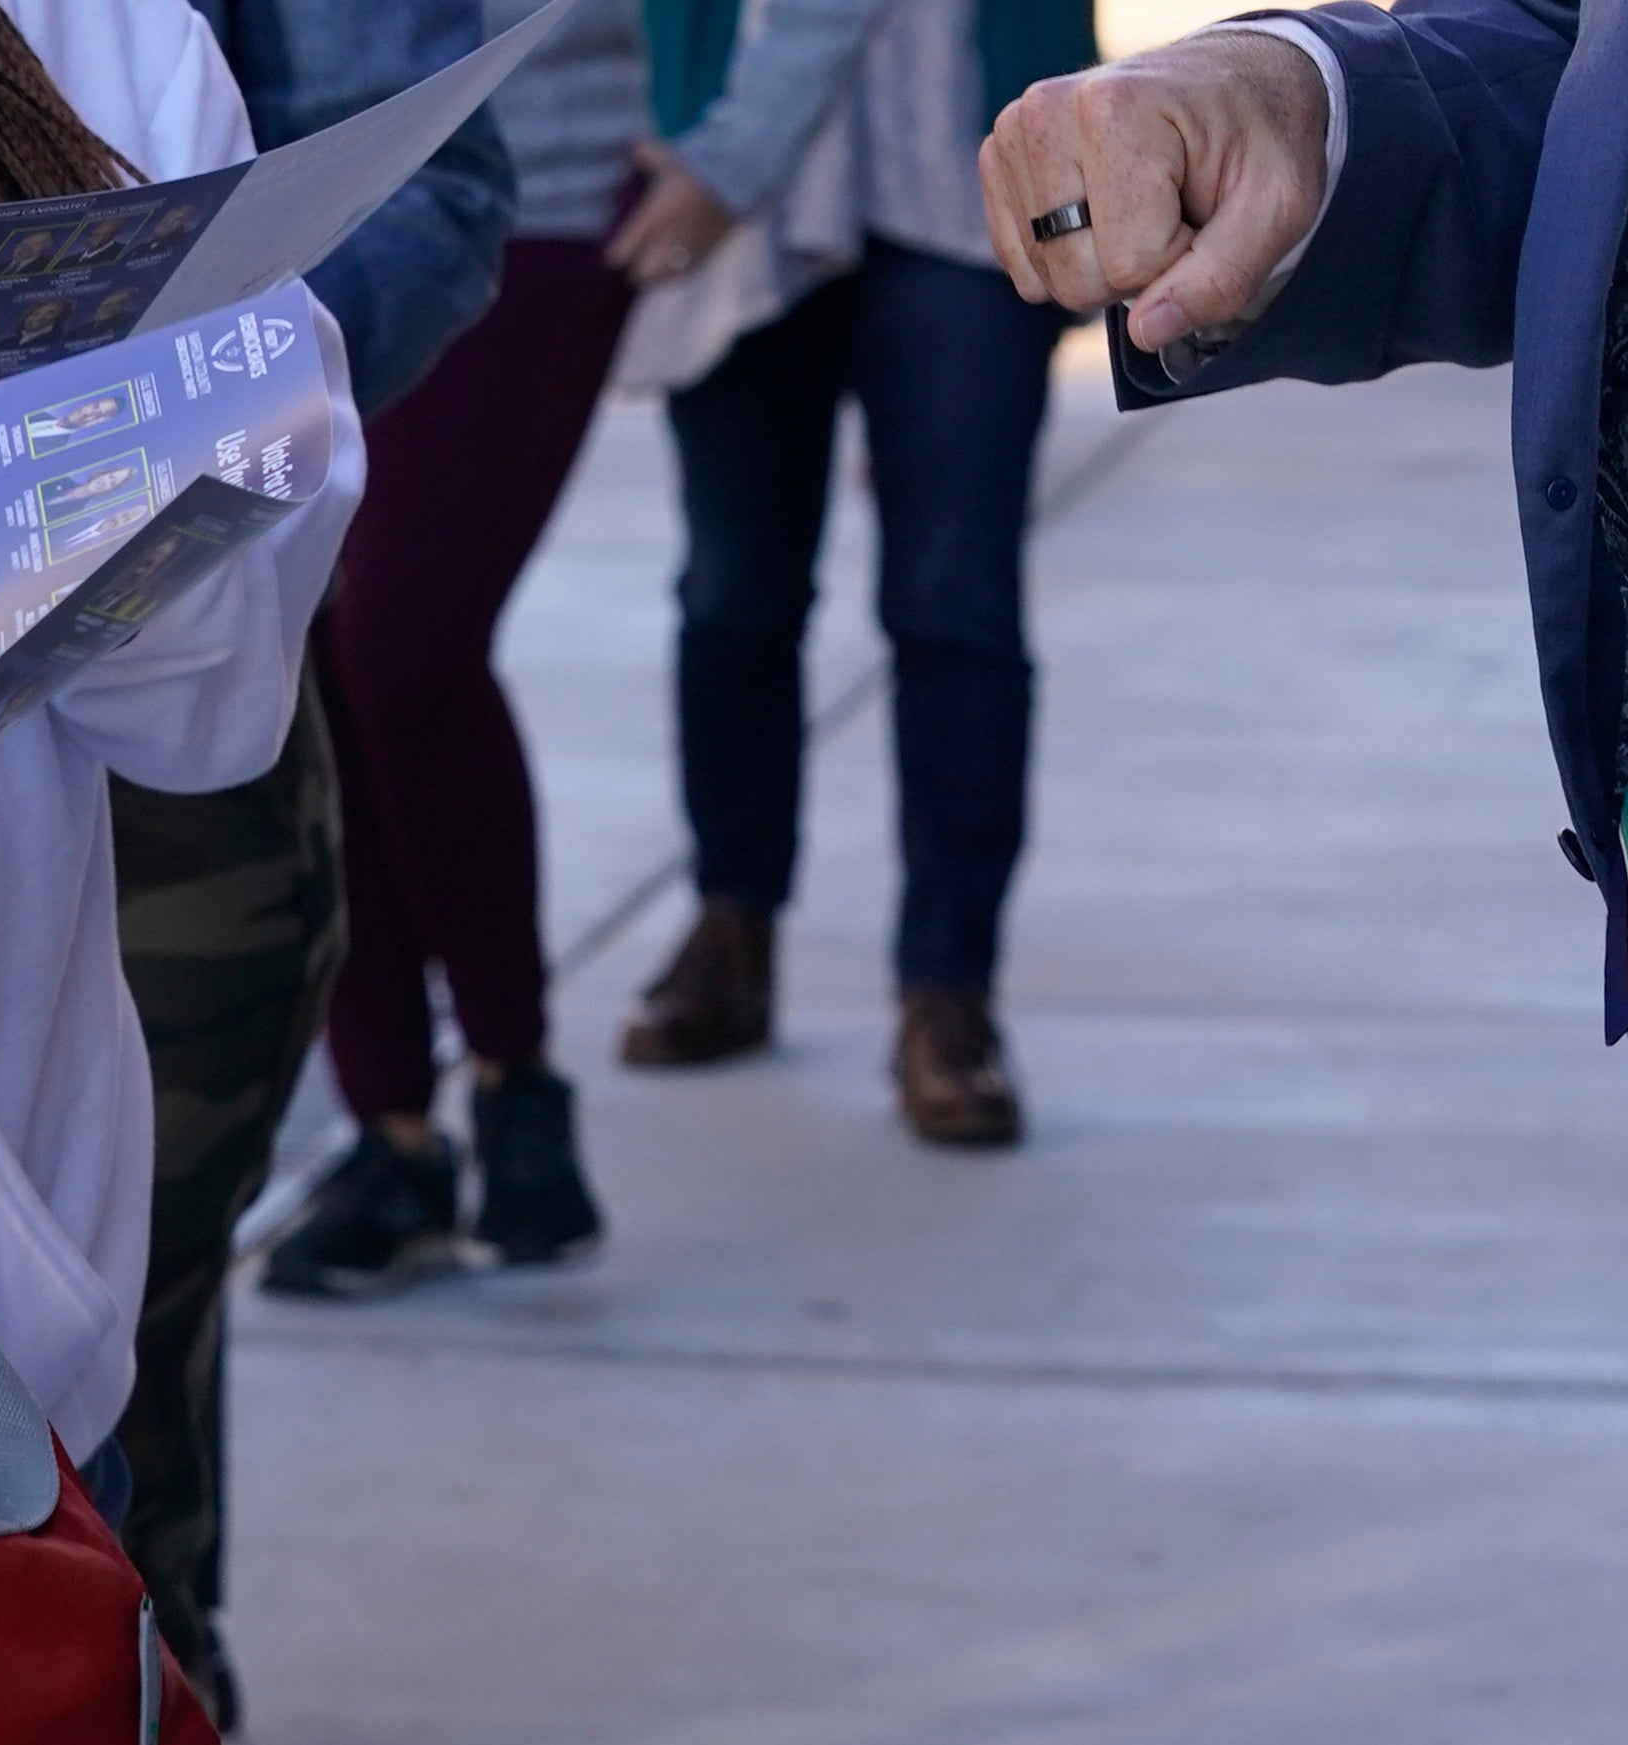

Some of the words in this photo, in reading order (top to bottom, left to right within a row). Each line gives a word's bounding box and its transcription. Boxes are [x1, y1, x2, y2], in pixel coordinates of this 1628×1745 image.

[239, 312, 267, 379] DEMOCRATS
[215, 429, 247, 468] Use
[261, 434, 291, 475] Vote
